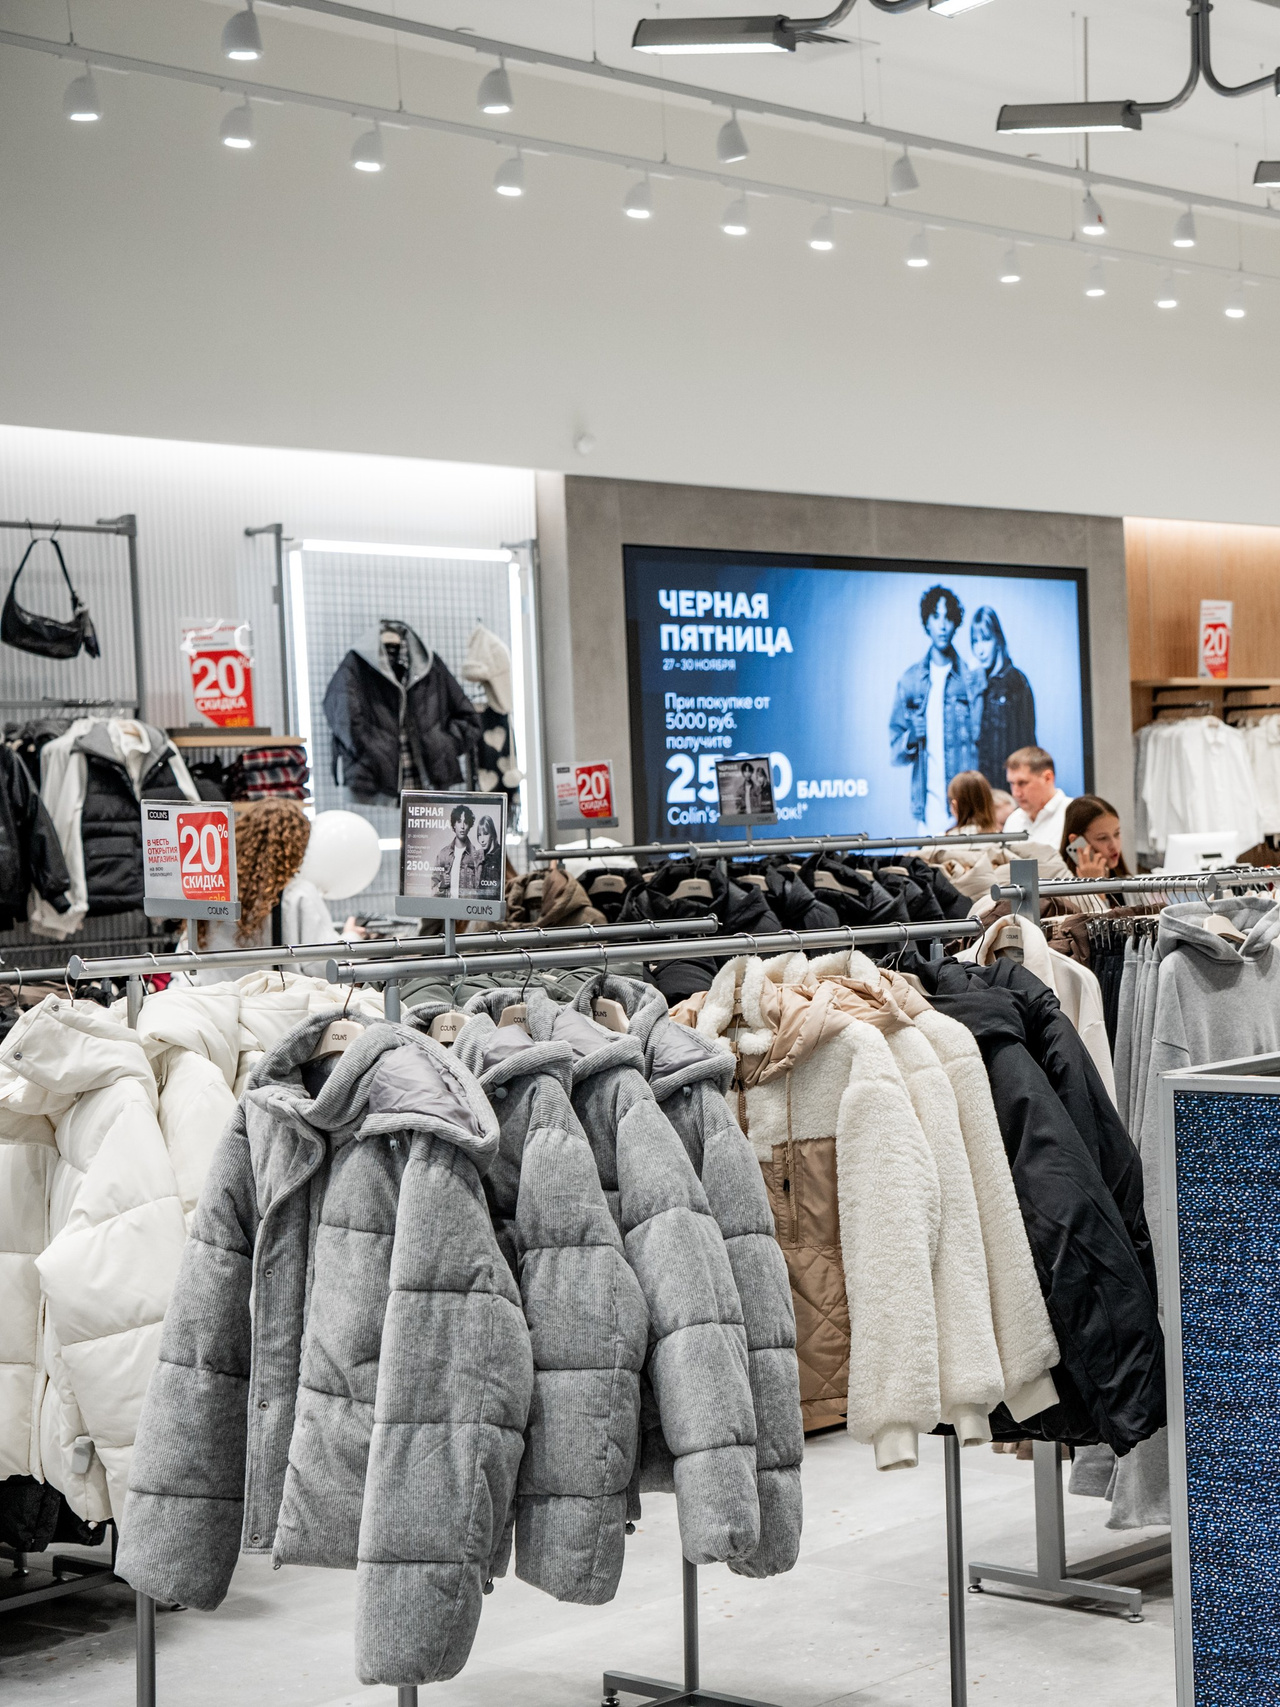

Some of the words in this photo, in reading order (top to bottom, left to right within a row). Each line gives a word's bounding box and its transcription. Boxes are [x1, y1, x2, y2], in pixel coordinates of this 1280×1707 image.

[658, 589, 769, 619] ЧЕРНАЯ
[660, 624, 794, 657] ПЯТНИЦА
[694, 659, 737, 671] НОЯБРЯ
[665, 692, 695, 712] При
[697, 697, 753, 713] покупке
[754, 697, 771, 710] от
[665, 712, 707, 729] 5000
[708, 712, 737, 733] руб.
[666, 735, 733, 753] получите
[796, 778, 869, 799] БАЛЛОВ
[149, 811, 168, 819] COLIN'S
[408, 806, 444, 817] ЧЕРНАЯ
[408, 818, 451, 830] ПЯТНИЦА
[152, 838, 170, 846] ЧЕСТЬ
[148, 846, 178, 855] ОТКРЫТИЯ
[148, 855, 179, 863] МАГАЗИНА
[406, 860, 430, 871] 2500
[183, 874, 225, 890] СКИДКА
[207, 906, 229, 915] COLIN'S
[466, 905, 493, 916] COLIN'S
[331, 1033, 347, 1041] COLIN'S
